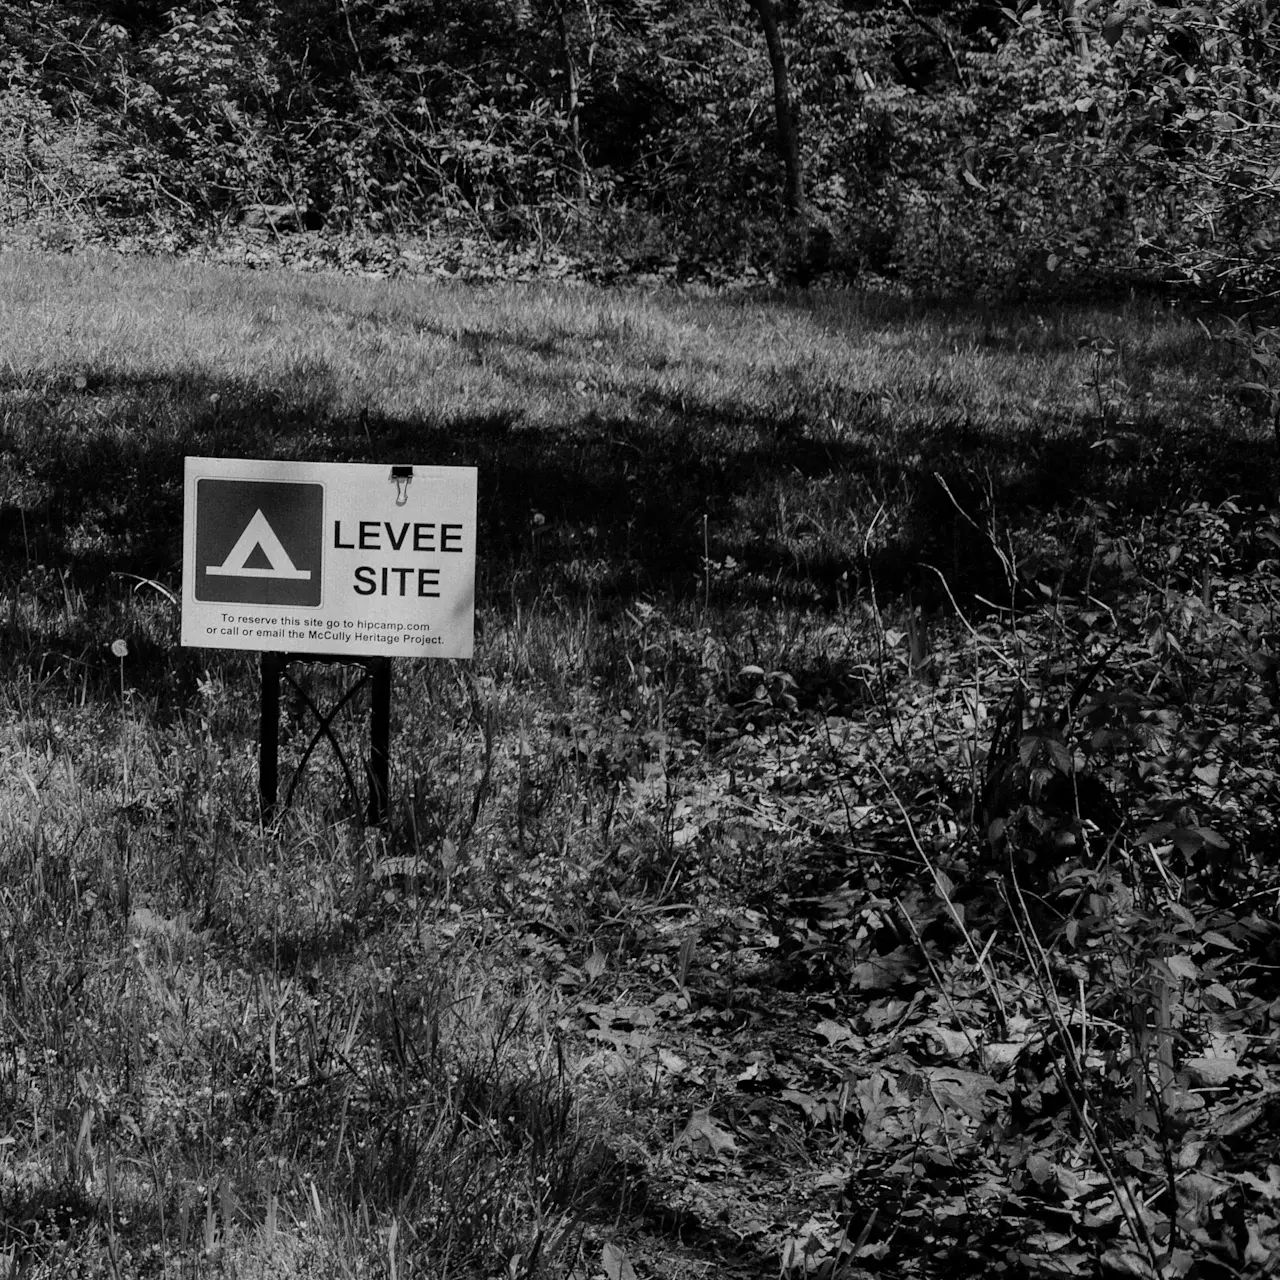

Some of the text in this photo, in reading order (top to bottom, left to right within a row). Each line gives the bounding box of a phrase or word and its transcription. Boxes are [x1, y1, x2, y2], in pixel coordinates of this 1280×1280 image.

[334, 520, 463, 553] LEVEE
[353, 566, 441, 598] SITE
[206, 626, 445, 645] or call or email the McCully Heritage Project.
[221, 614, 430, 632] To reserve this site go to hipcamp.com
